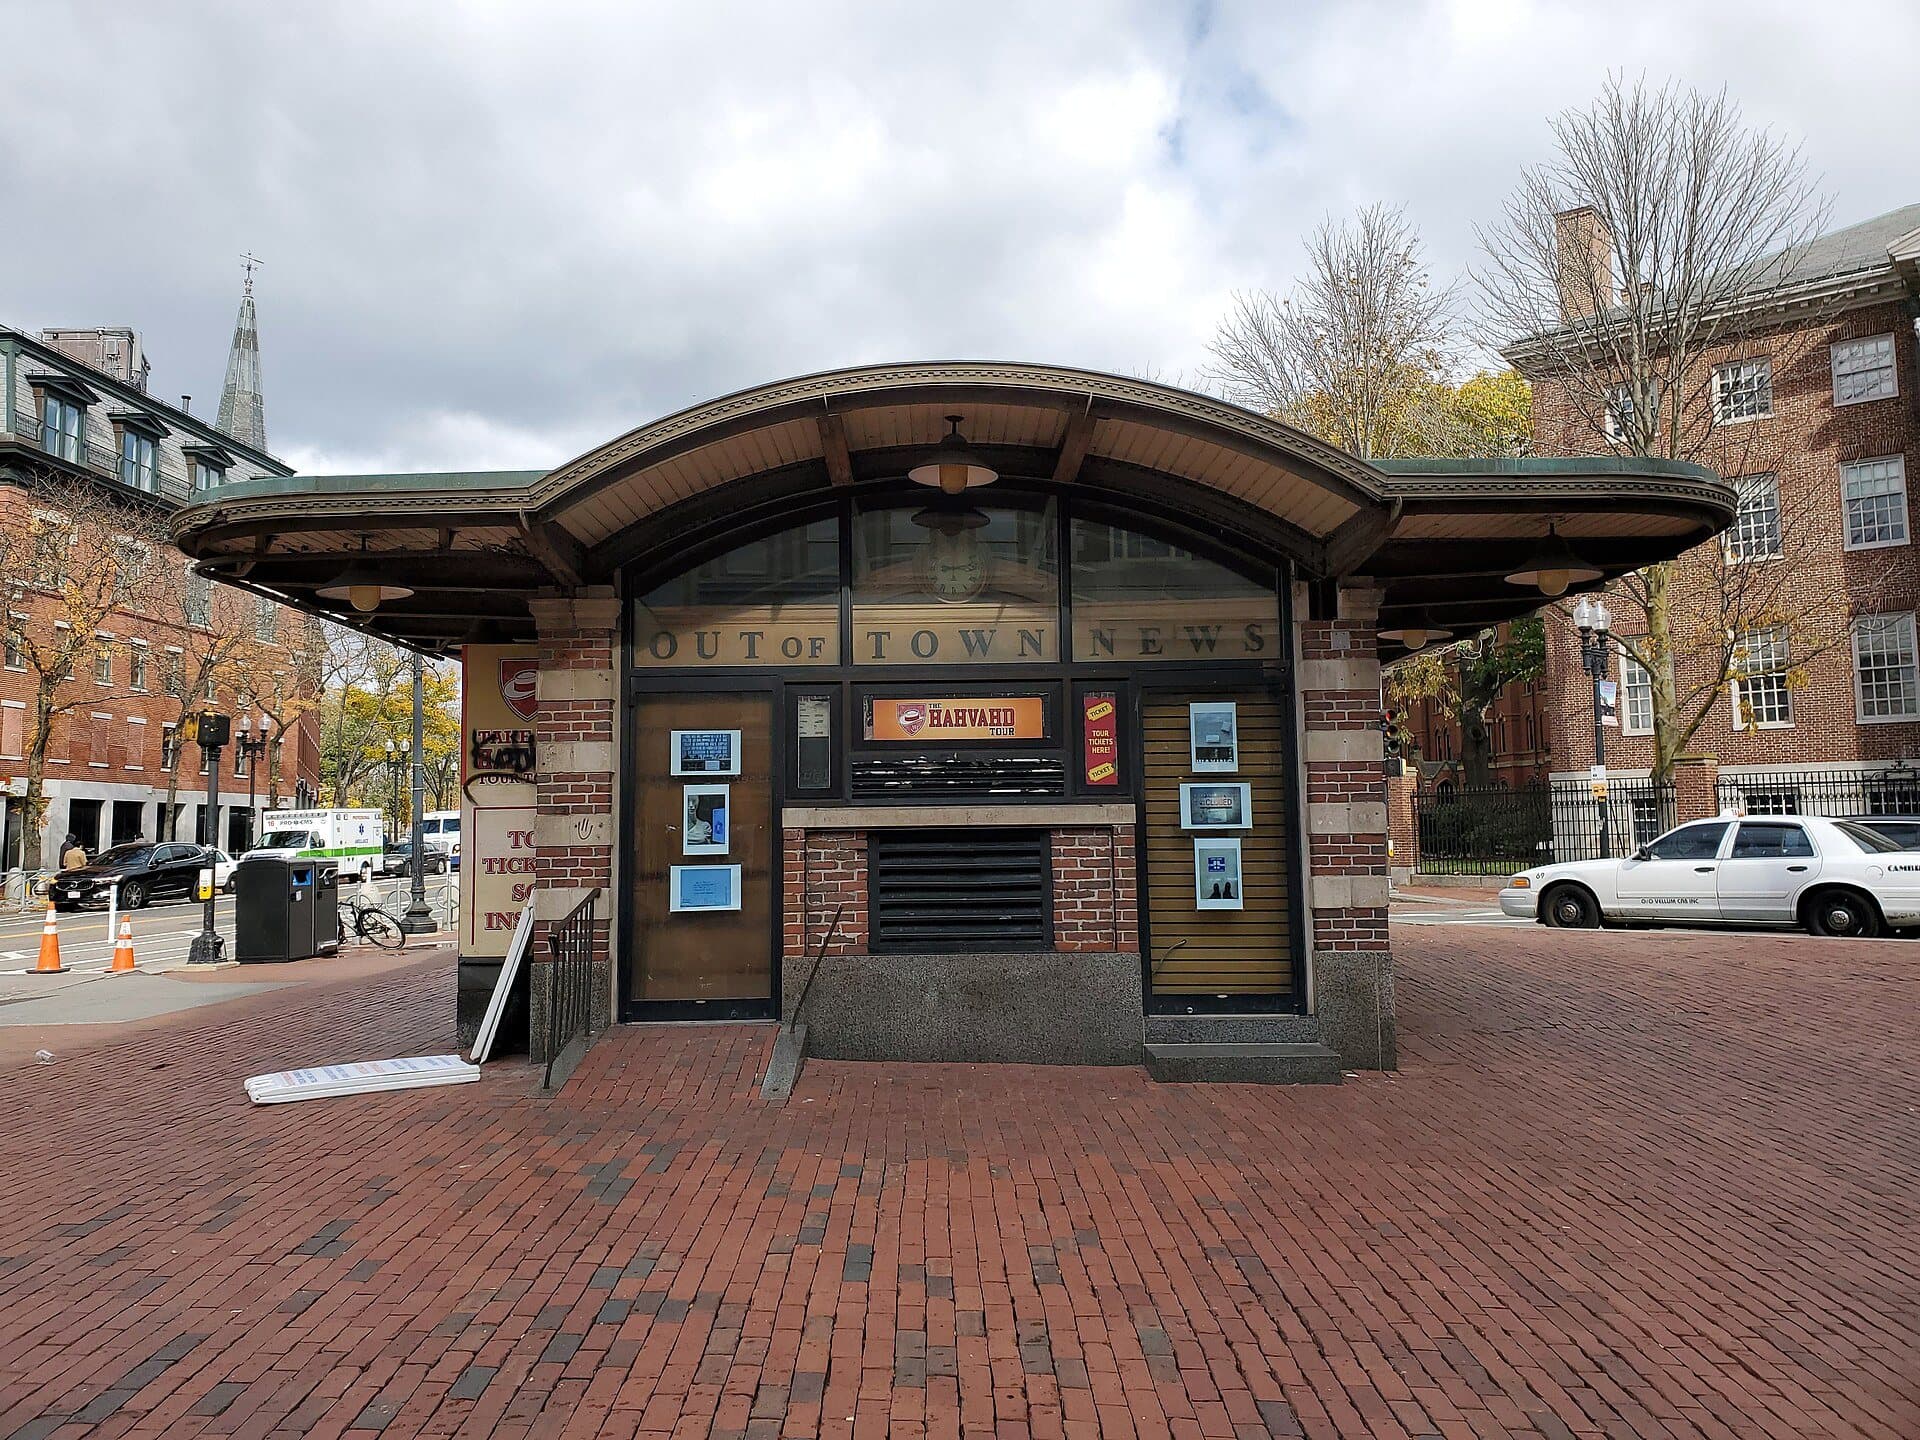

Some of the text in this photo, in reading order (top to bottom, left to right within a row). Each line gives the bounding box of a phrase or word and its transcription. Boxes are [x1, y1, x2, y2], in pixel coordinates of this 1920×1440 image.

[650, 624, 1265, 660] OUT OF TOWN NEWS
[929, 708, 1015, 728] HAHVAHD
[1090, 705, 1109, 718] TICKET
[989, 727, 1015, 736] TOUR
[1092, 765, 1110, 778] TICKET
[1535, 872, 1545, 880] 69
